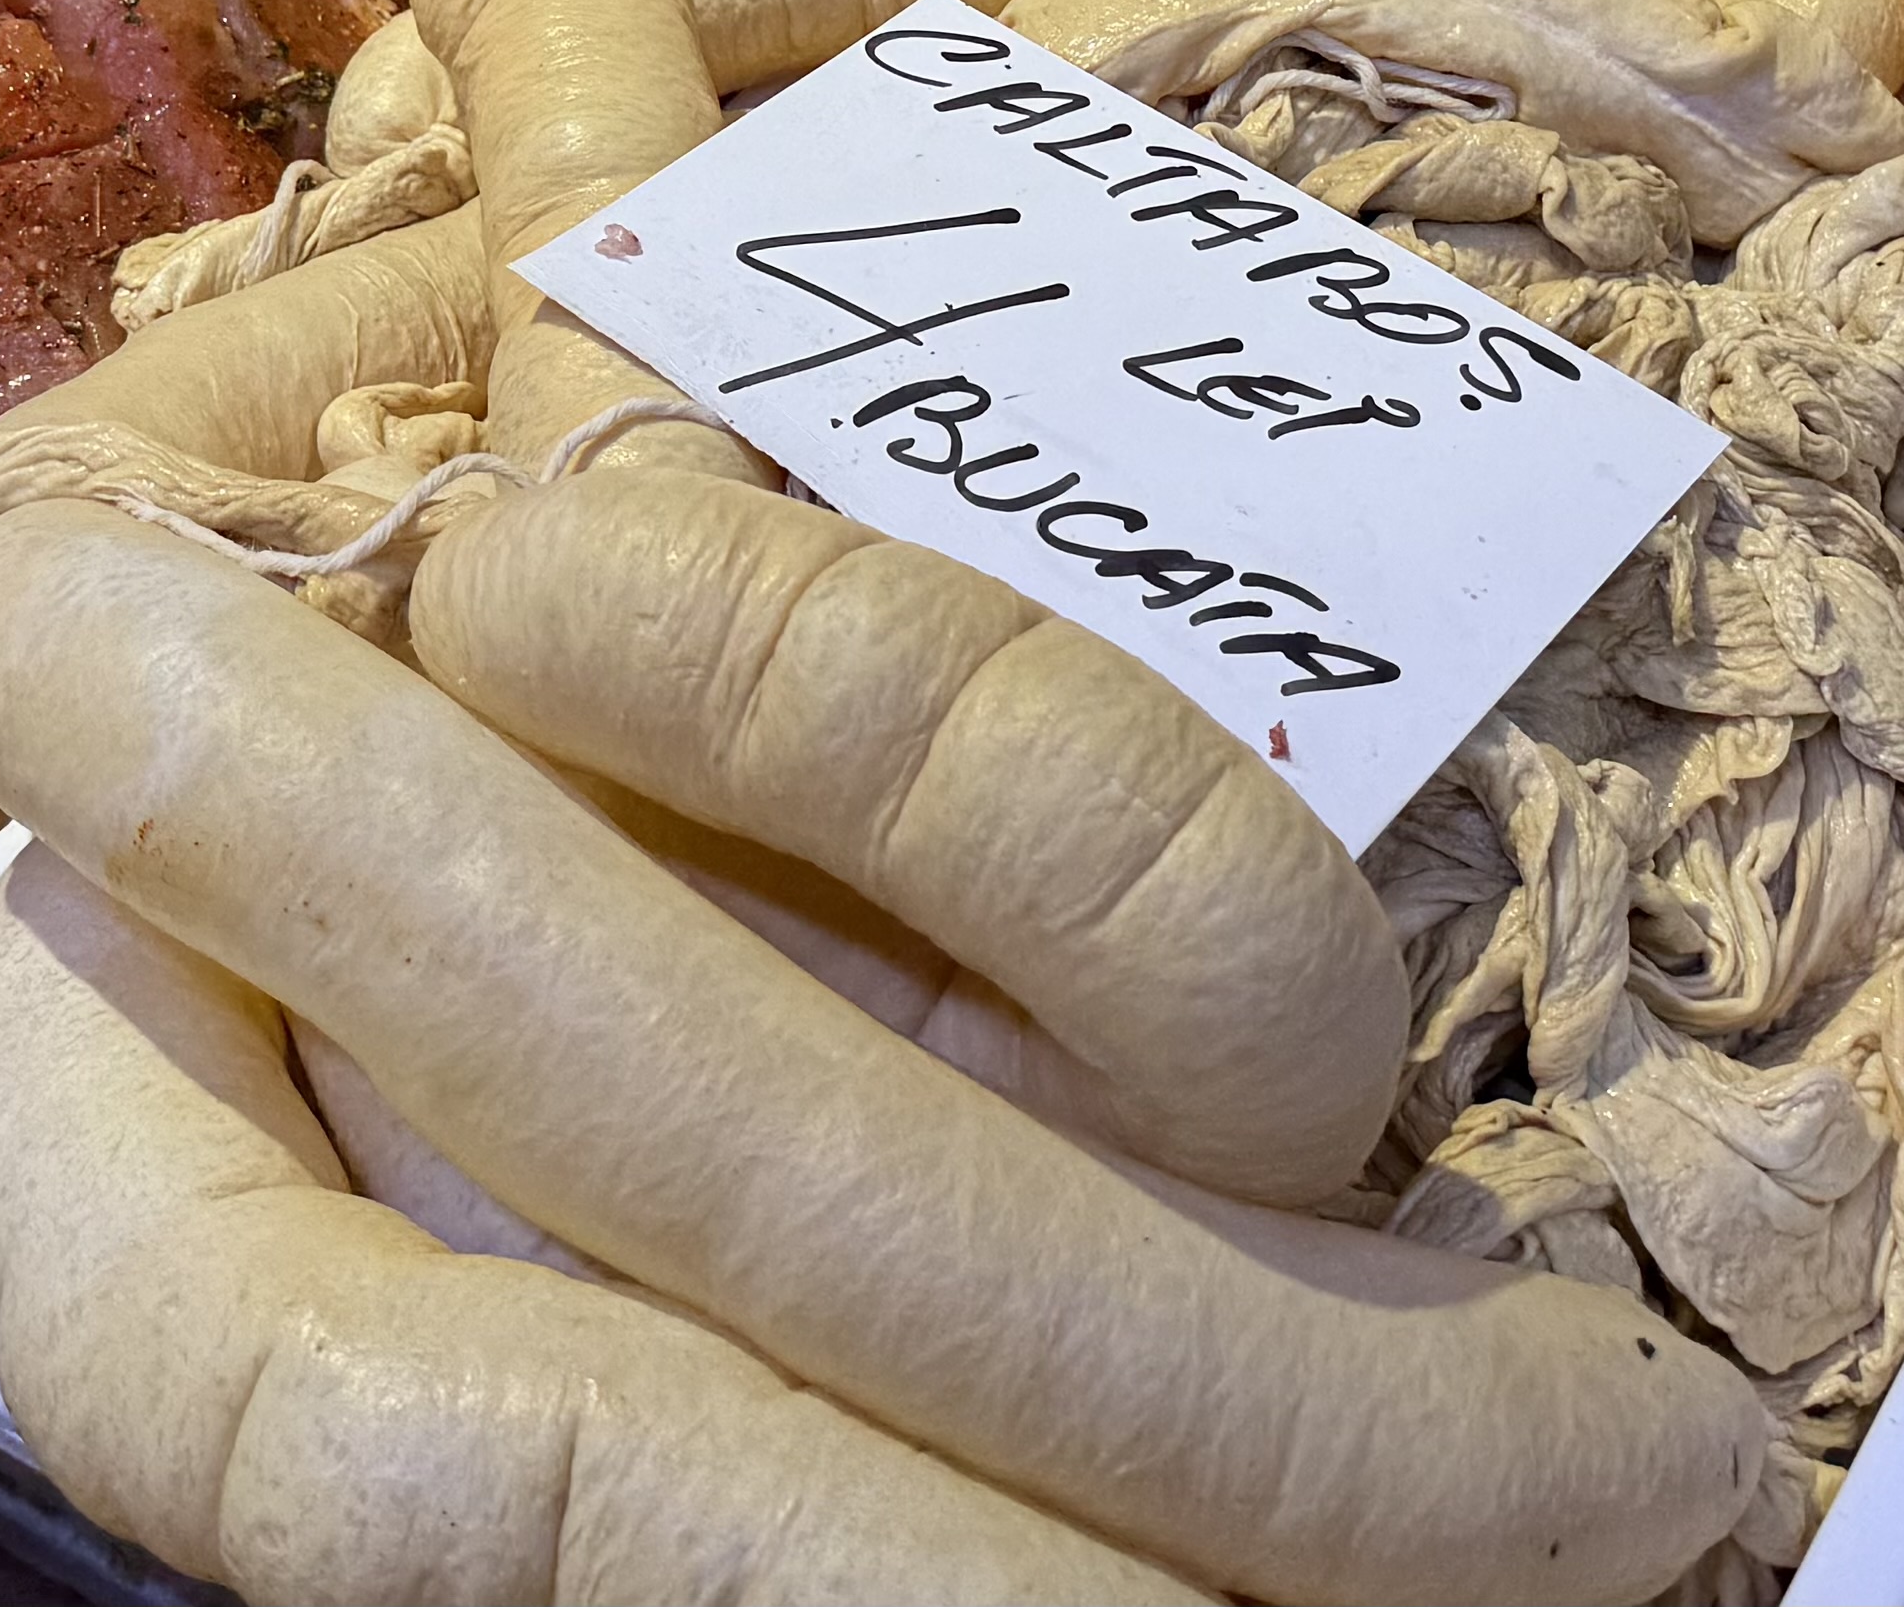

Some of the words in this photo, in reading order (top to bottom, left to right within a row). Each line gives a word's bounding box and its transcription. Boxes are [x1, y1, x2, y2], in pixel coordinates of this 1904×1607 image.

[717, 206, 1072, 396] 4
[1121, 336, 1423, 442] LEI
[852, 374, 1403, 698] BUCATA
